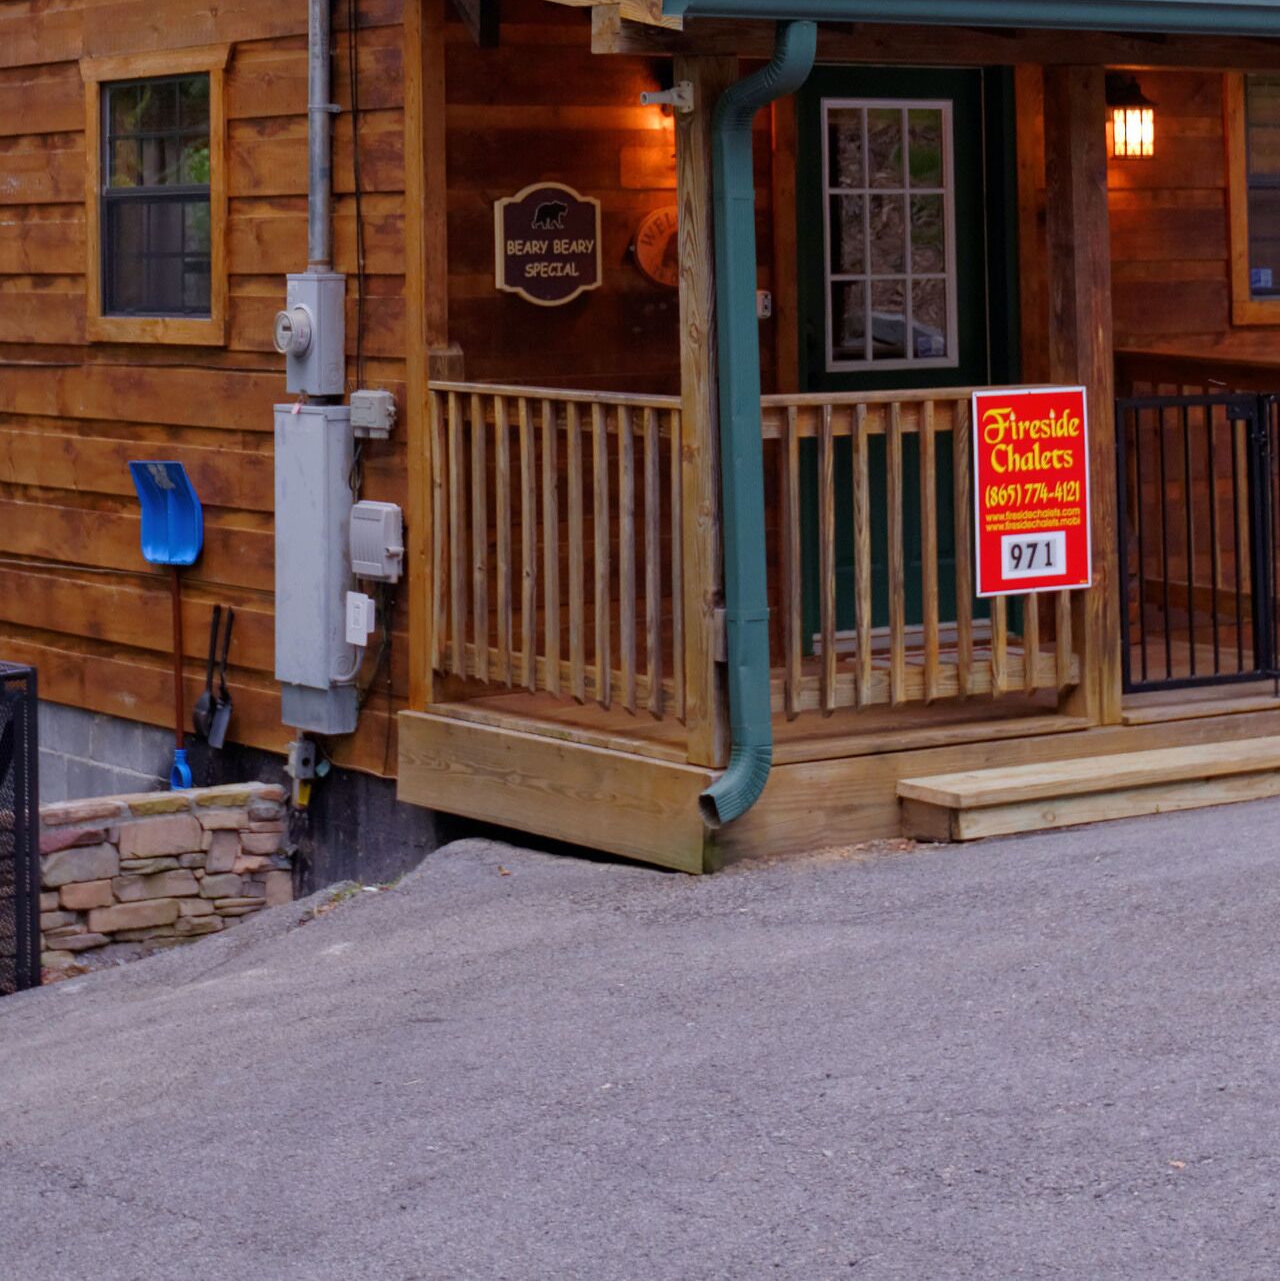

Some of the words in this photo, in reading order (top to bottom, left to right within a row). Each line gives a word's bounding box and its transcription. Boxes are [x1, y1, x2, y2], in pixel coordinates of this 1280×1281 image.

[507, 240, 548, 255] BEARY
[553, 239, 594, 254] BEARY
[524, 262, 579, 277] SPECIAL
[982, 407, 1080, 444] Fireside
[991, 442, 1073, 473] Chalets
[985, 484, 1021, 507] (865)
[1024, 480, 1080, 504] 774-4121
[1010, 541, 1053, 569] 971
